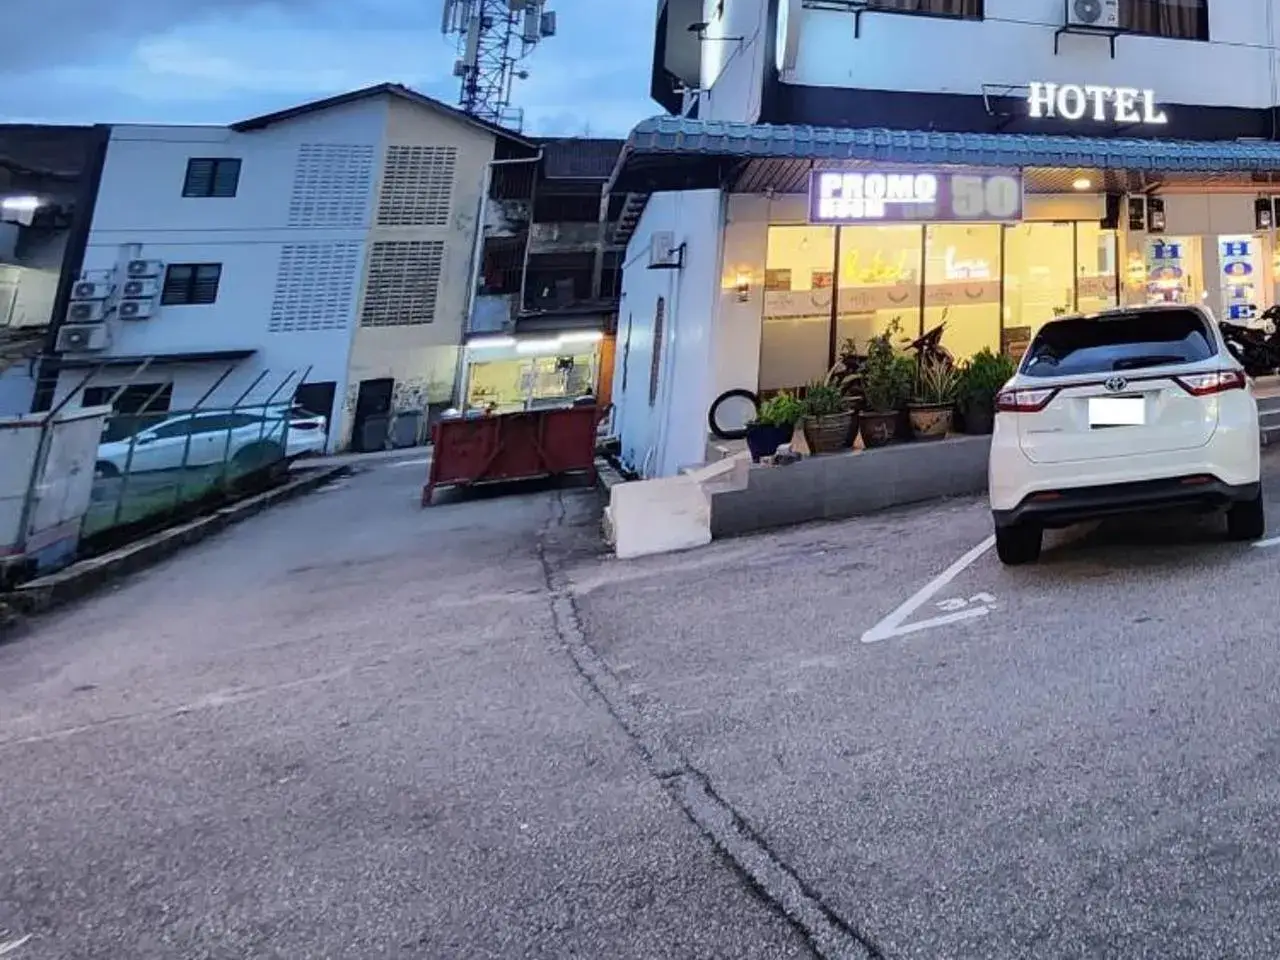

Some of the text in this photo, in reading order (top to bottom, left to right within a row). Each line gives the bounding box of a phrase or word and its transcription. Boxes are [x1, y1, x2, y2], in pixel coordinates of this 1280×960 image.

[1027, 81, 1168, 124] HOTEL
[820, 173, 1019, 218] PROMO 50
